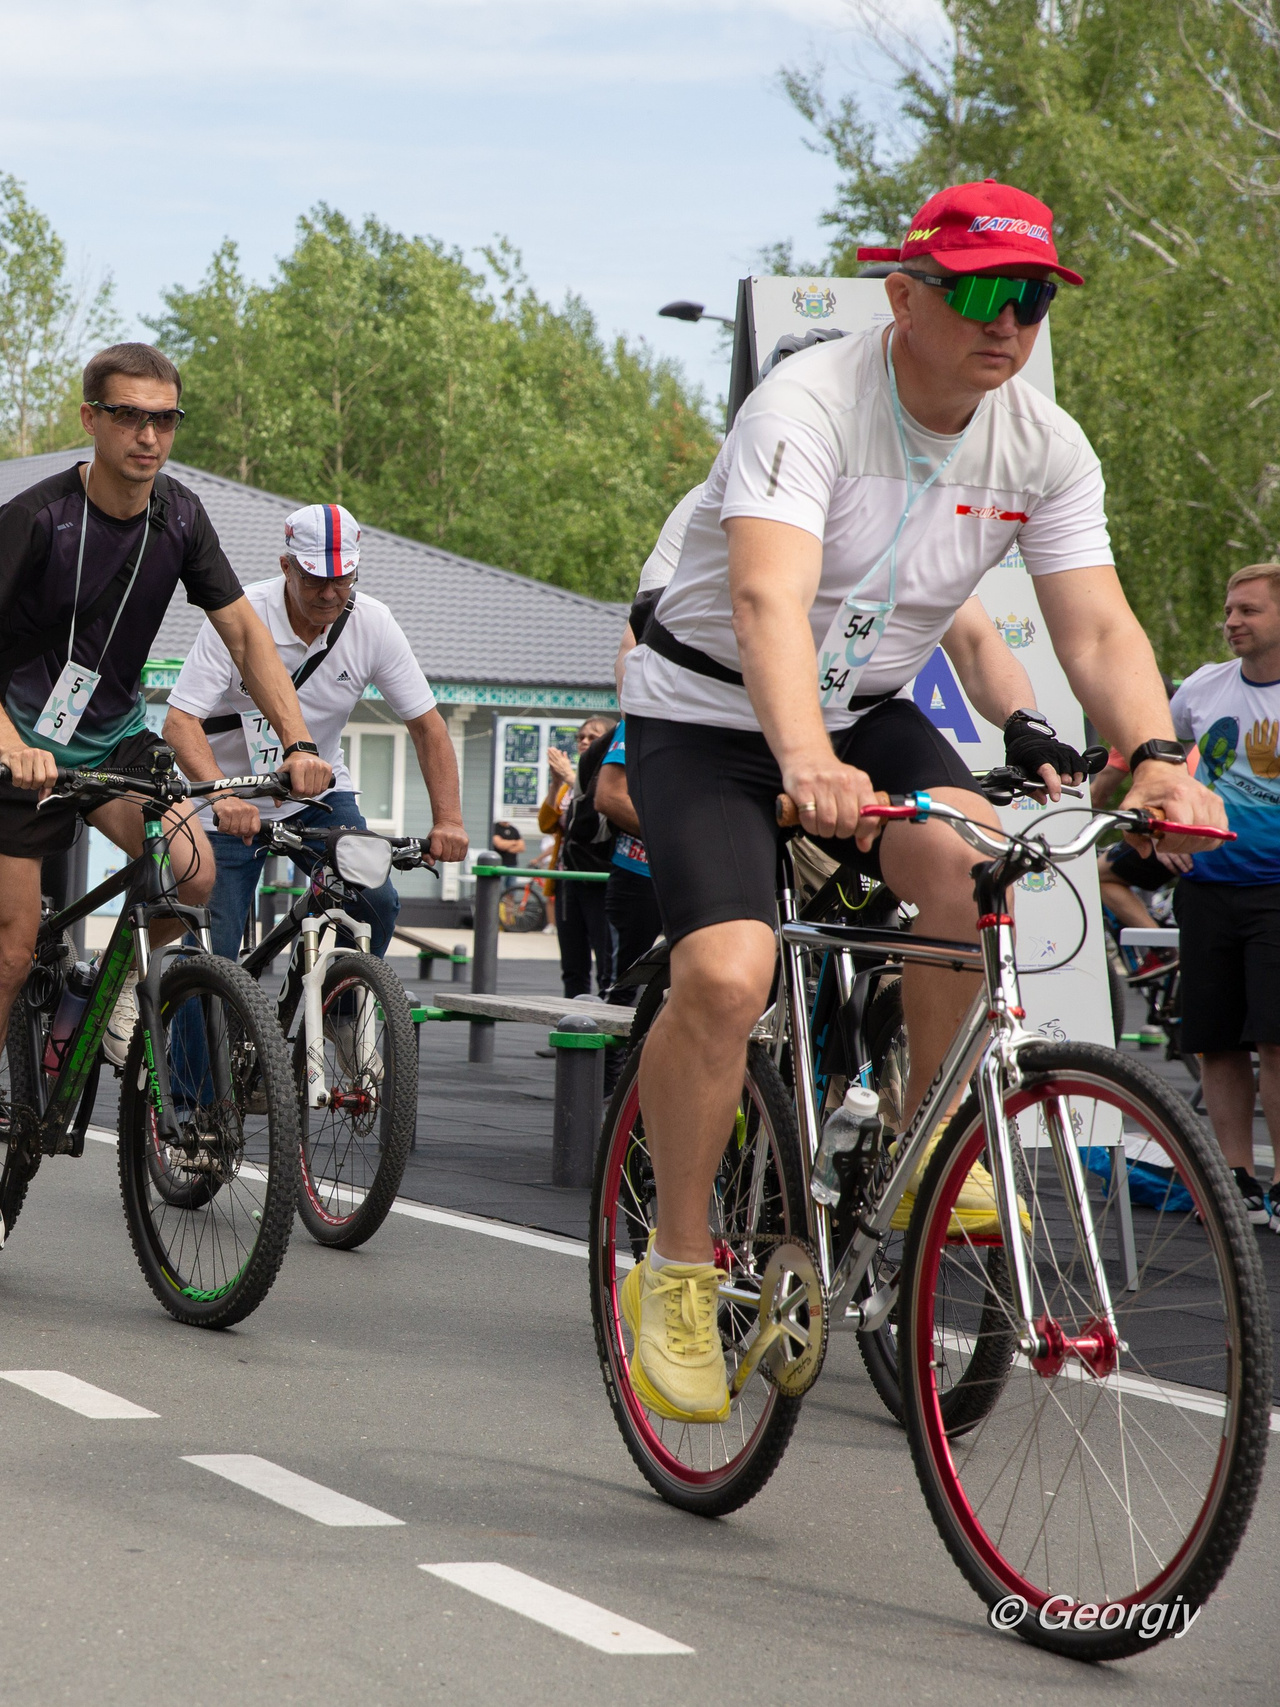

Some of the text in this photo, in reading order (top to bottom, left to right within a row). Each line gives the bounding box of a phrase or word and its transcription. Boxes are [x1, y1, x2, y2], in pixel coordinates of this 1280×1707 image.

[999, 552, 1025, 568] ЕСТО
[844, 614, 876, 639] 54
[71, 677, 84, 694] 5
[820, 668, 851, 692] 54
[54, 711, 67, 729] 5
[252, 717, 271, 733] 77
[259, 747, 278, 764] 77
